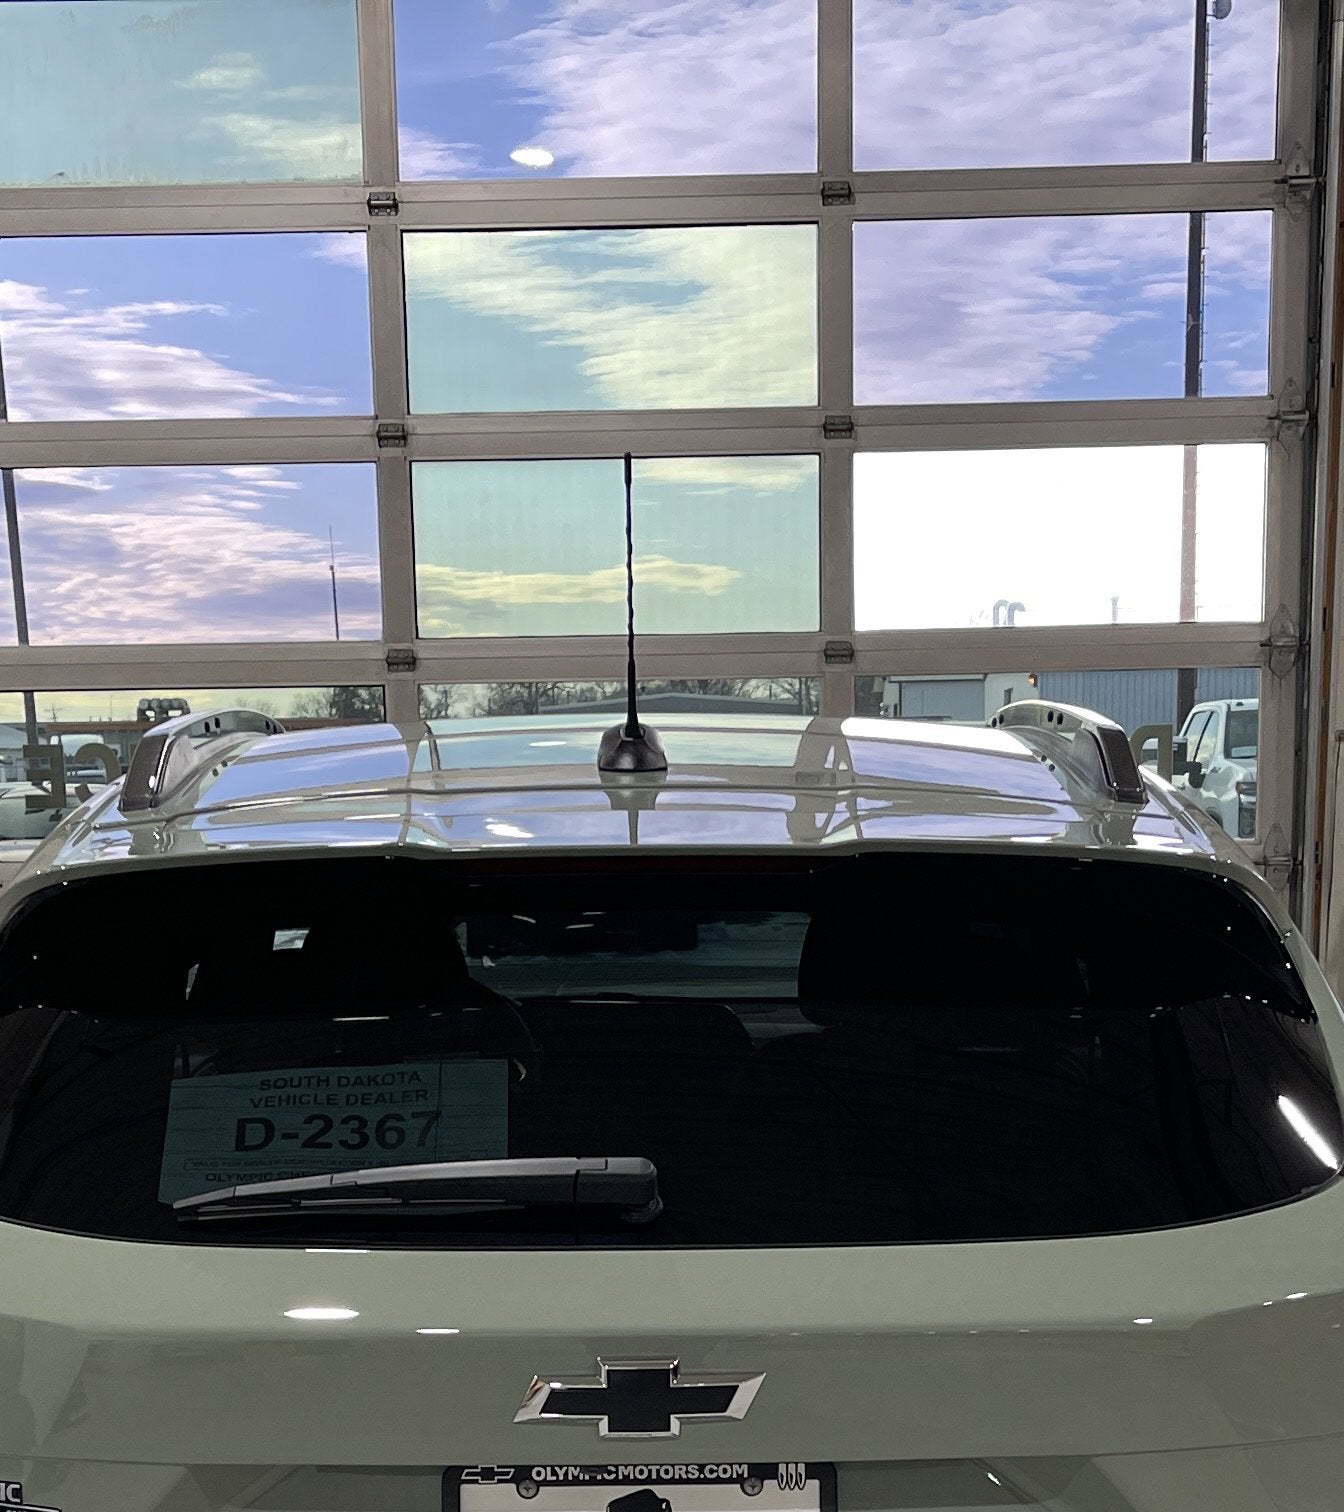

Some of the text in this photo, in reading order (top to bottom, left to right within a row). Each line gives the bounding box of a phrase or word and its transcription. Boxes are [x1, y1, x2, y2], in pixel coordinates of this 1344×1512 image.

[259, 1071, 422, 1091] SOUTH DAKOTA
[250, 1089, 429, 1108] VEHICLE DEALER
[235, 1110, 443, 1151] D-2367
